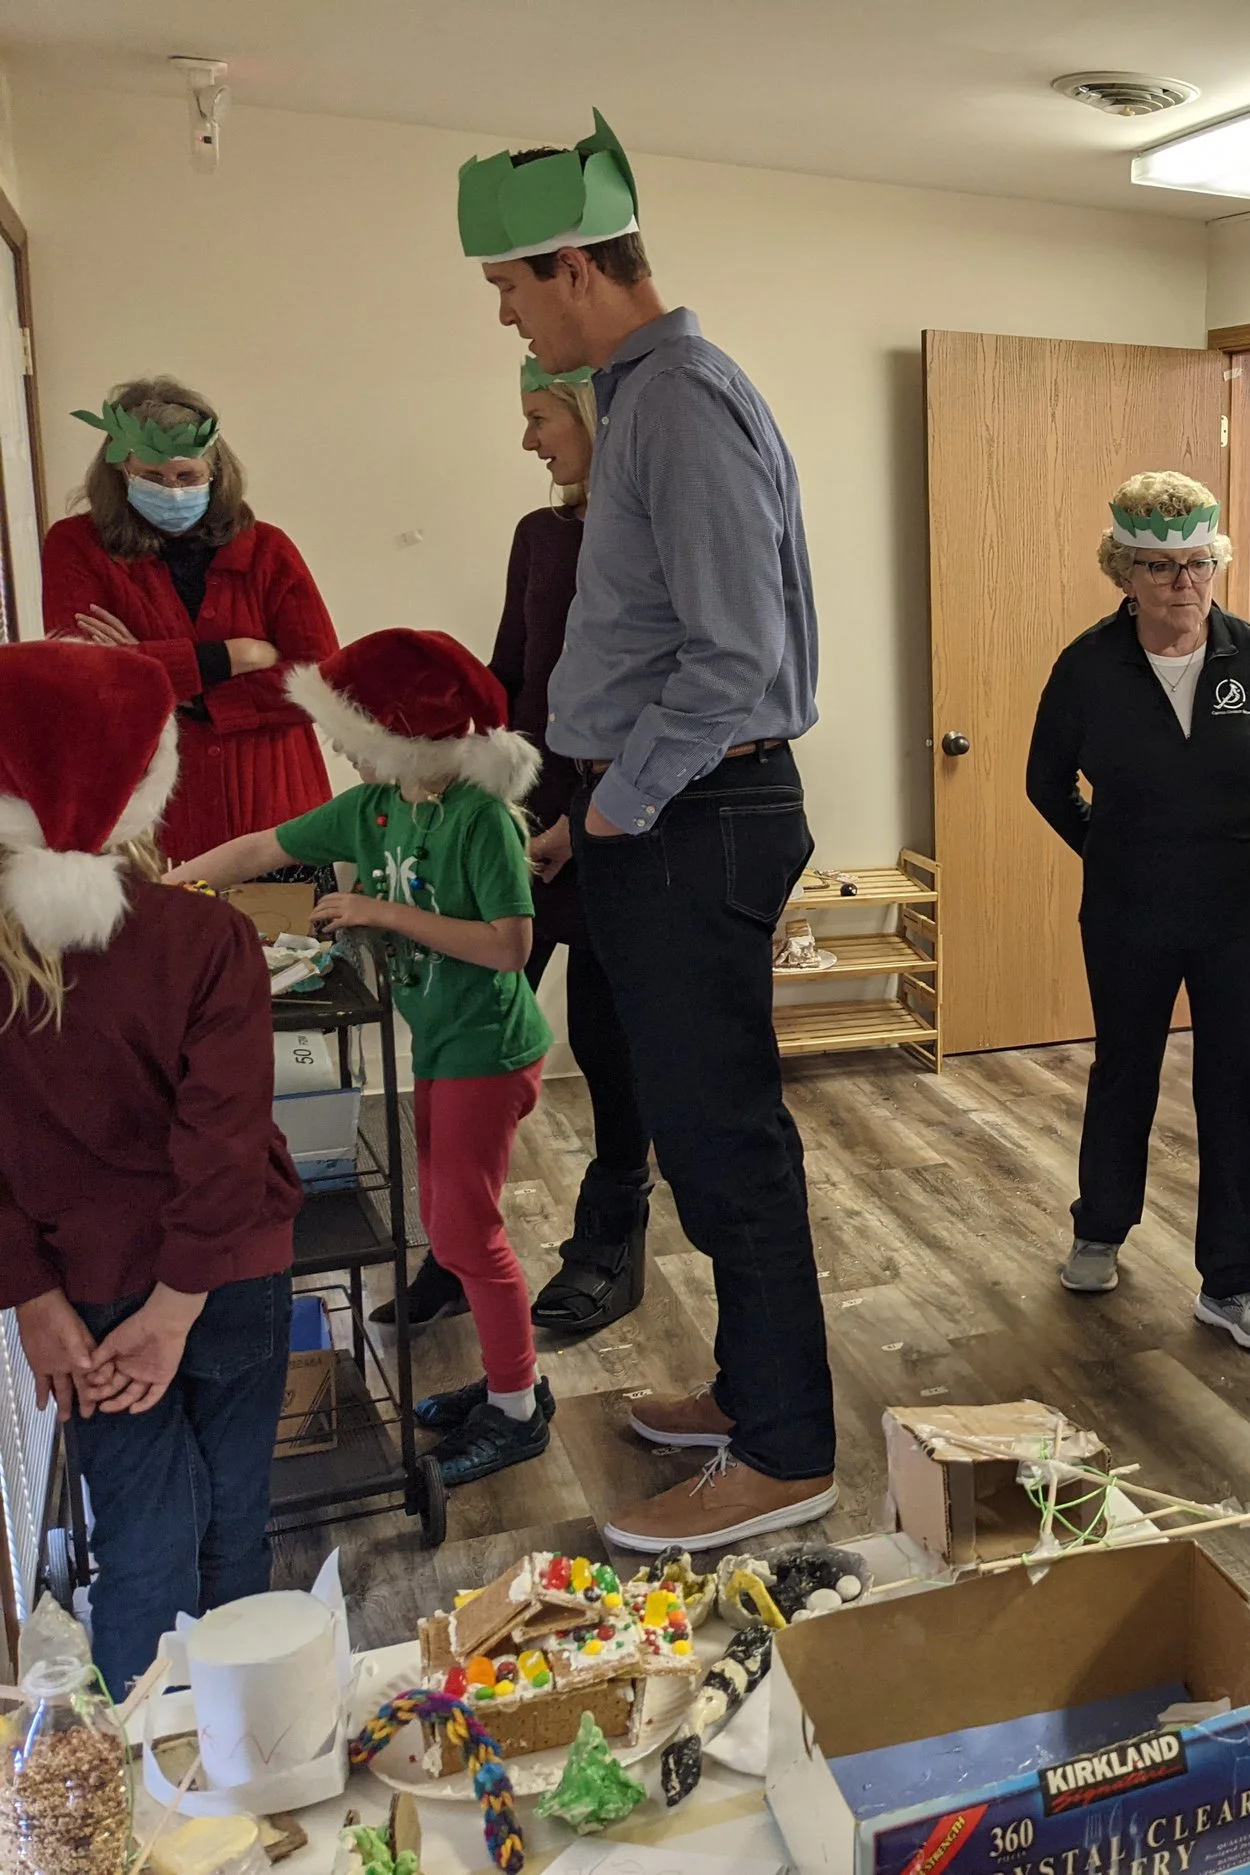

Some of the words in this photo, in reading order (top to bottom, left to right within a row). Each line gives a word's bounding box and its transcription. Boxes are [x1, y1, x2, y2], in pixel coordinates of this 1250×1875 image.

[293, 1049, 314, 1064] 50
[1047, 1734, 1180, 1795] KIRKLAND
[1051, 1764, 1184, 1813] Signature
[926, 1816, 965, 1871] STRENGTH
[989, 1818, 1034, 1857] 360
[992, 1835, 1125, 1875] YSTAL
